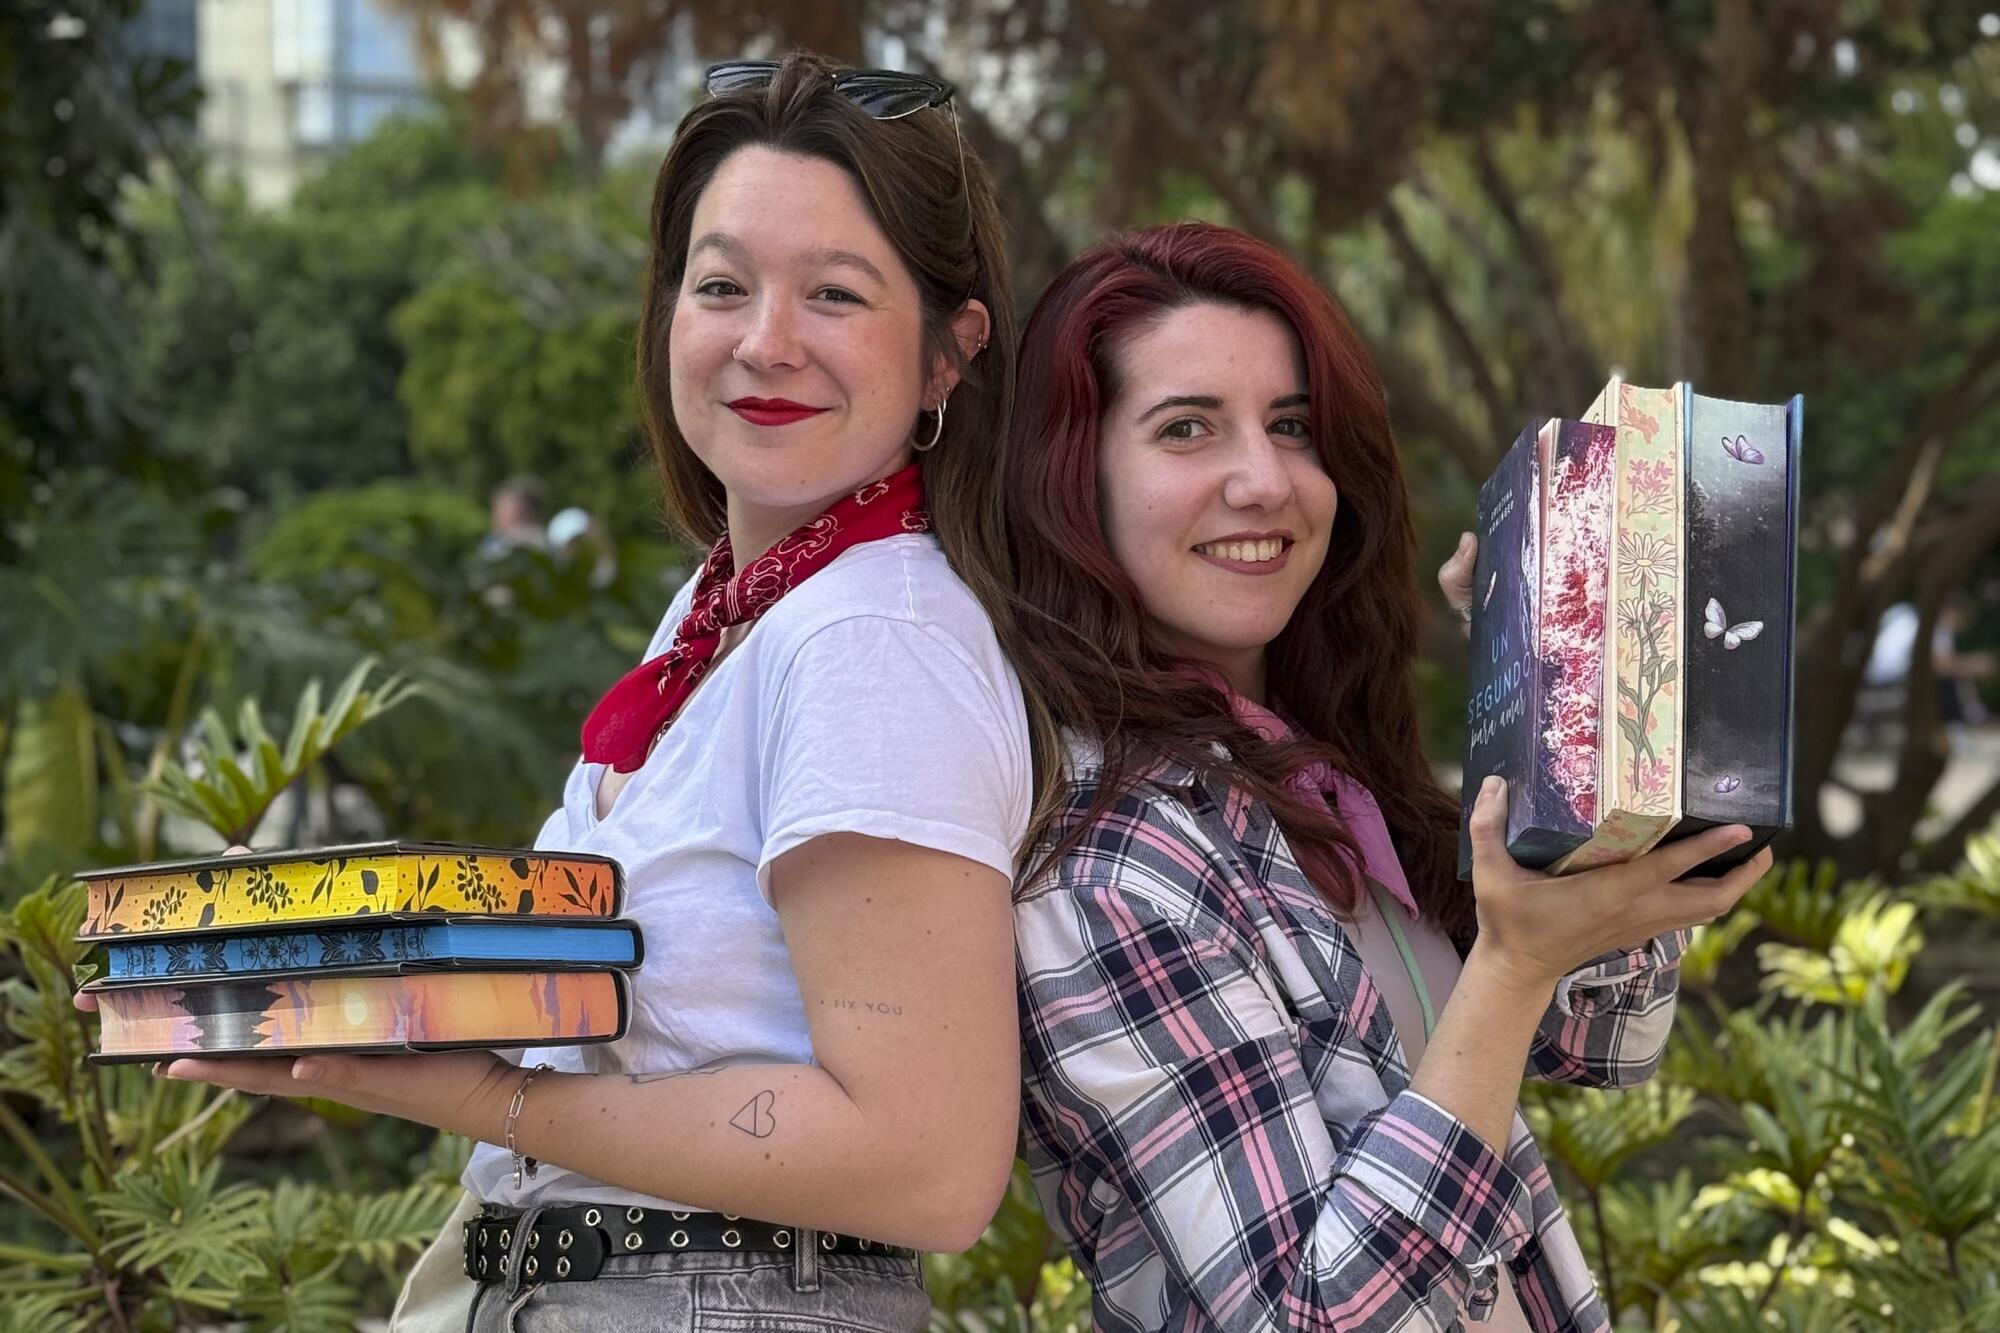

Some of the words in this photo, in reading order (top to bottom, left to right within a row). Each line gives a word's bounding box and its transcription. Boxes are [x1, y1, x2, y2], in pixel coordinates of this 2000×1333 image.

[1492, 627, 1508, 664] UN
[1468, 651, 1531, 724] SEGUNDO
[1469, 718, 1497, 760] para
[1500, 688, 1527, 727] amar
[834, 1000, 856, 1010] FIX
[865, 1002, 902, 1015] YOU
